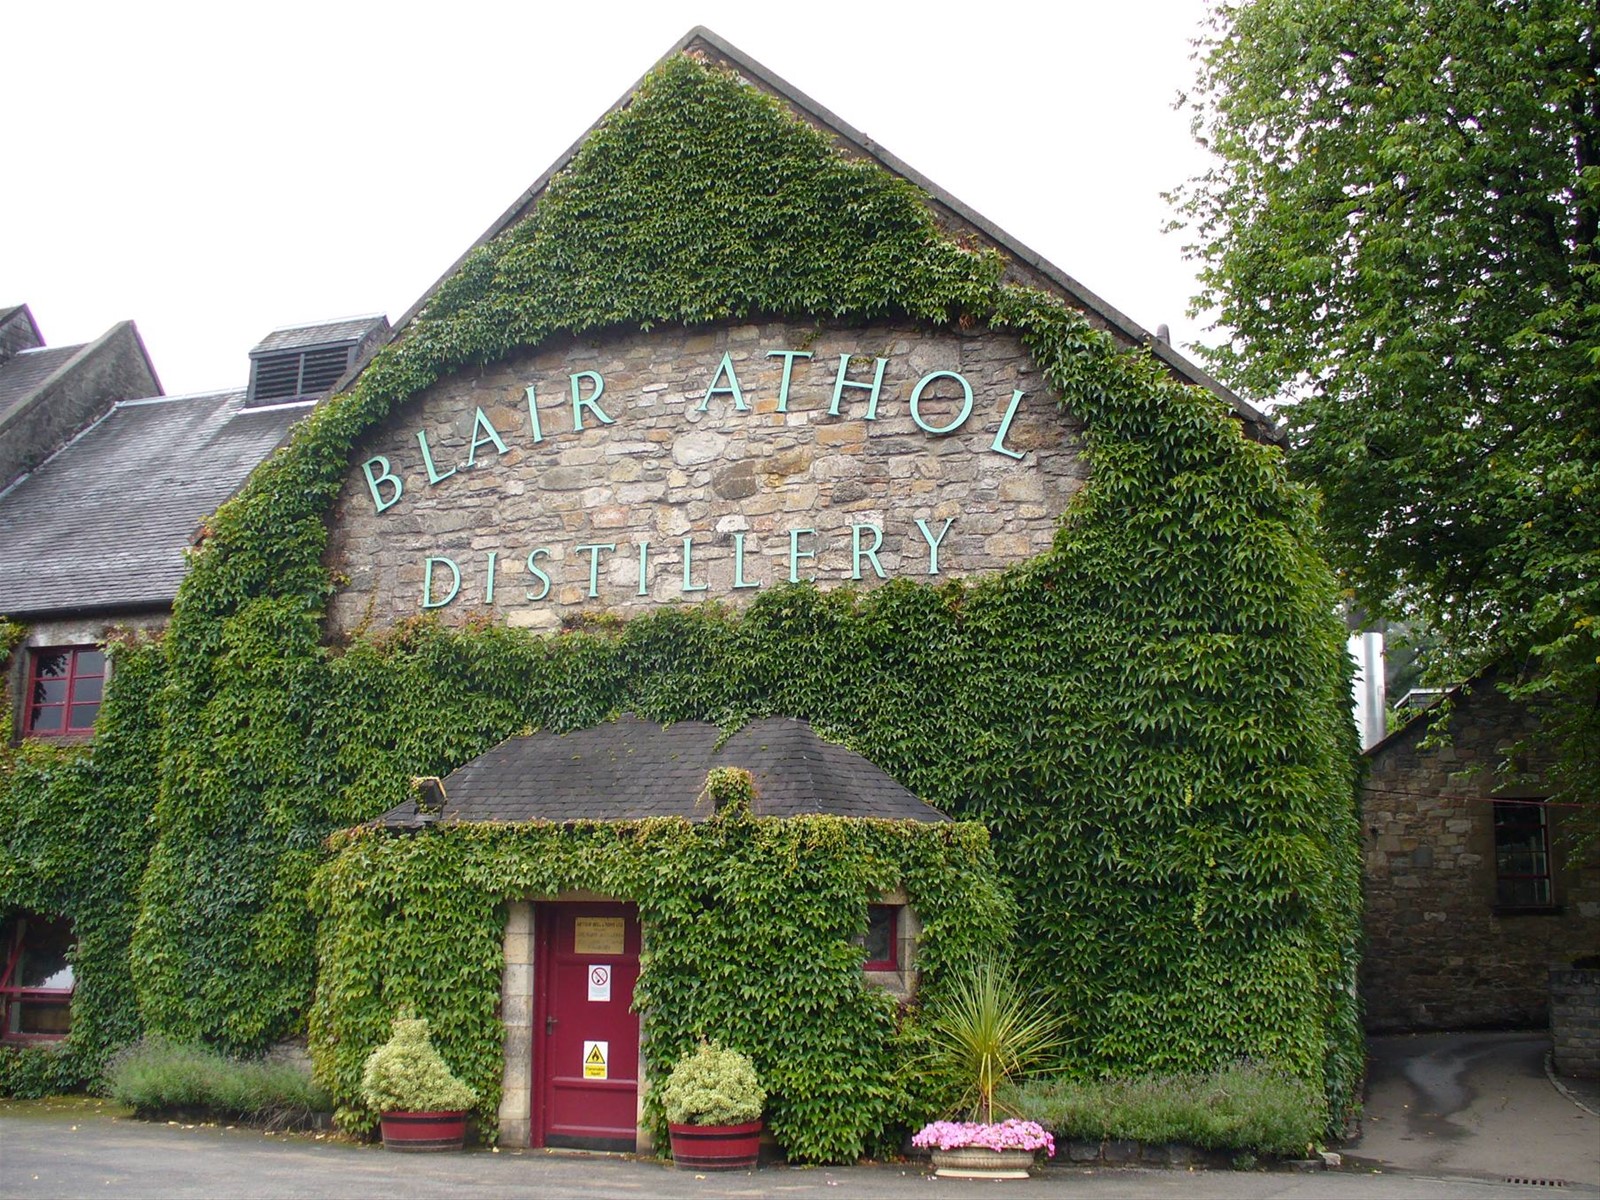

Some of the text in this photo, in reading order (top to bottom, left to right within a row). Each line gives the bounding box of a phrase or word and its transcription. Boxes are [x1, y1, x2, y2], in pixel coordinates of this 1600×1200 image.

[361, 350, 1026, 513] BLAIR ATHOL
[421, 518, 956, 608] DISTILLERY
